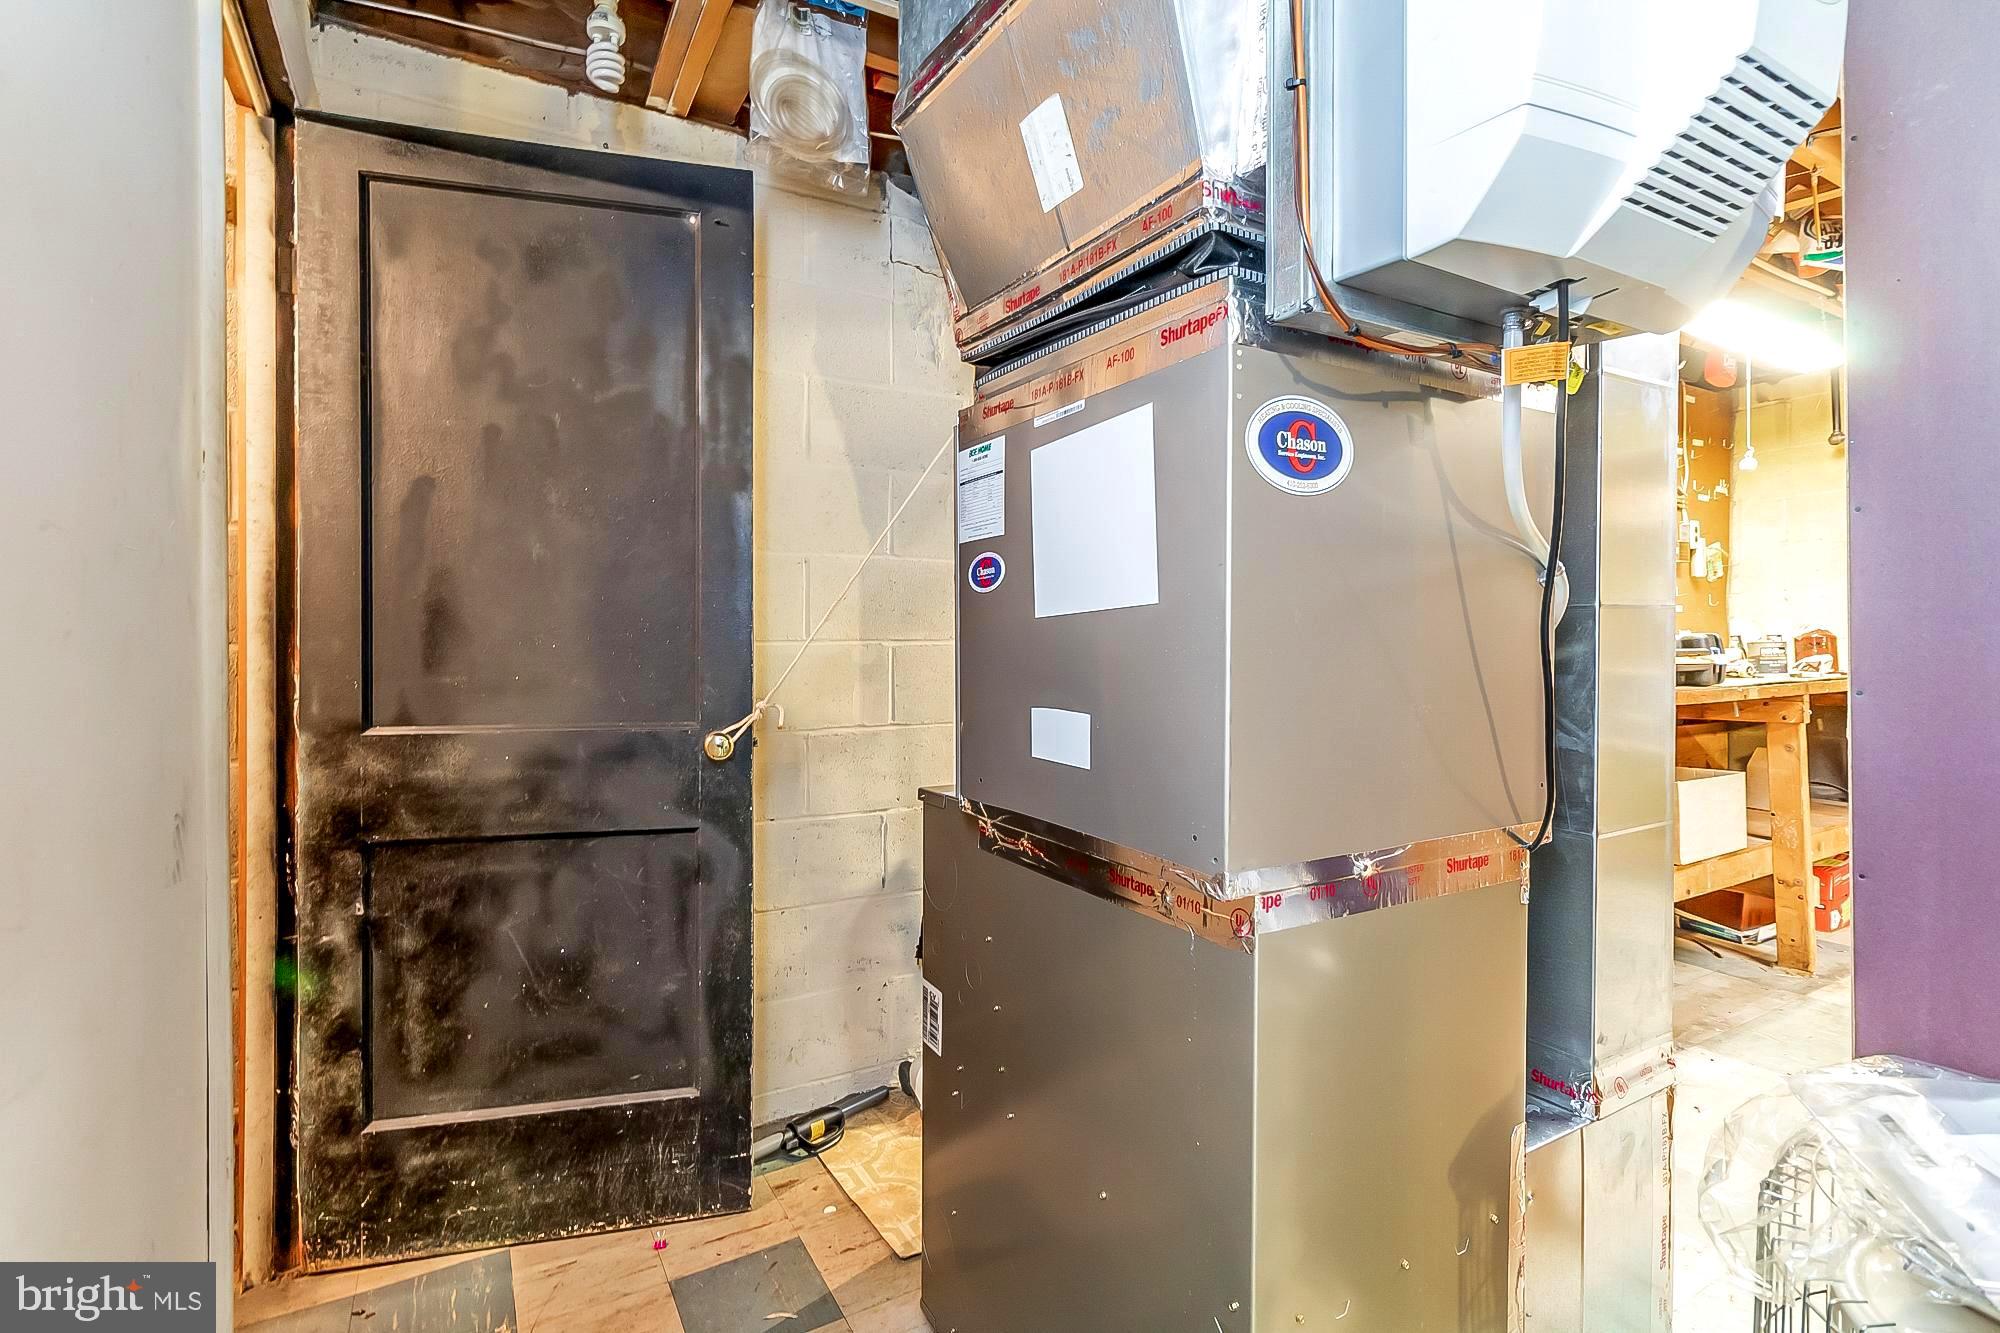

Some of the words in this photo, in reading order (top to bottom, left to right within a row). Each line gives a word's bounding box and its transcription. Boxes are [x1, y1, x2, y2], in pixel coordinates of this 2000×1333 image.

[1005, 285, 1040, 313] Shurtape
[1142, 205, 1173, 232] AF-100
[1106, 347, 1135, 370] AF-100
[982, 399, 1015, 420] Shurtape
[1276, 430, 1327, 453] Chason
[1446, 854, 1489, 874] Shurtape
[1109, 868, 1155, 898] Shurtape
[1176, 894, 1201, 915] 01/10
[1659, 1215, 1668, 1271] Shurtape
